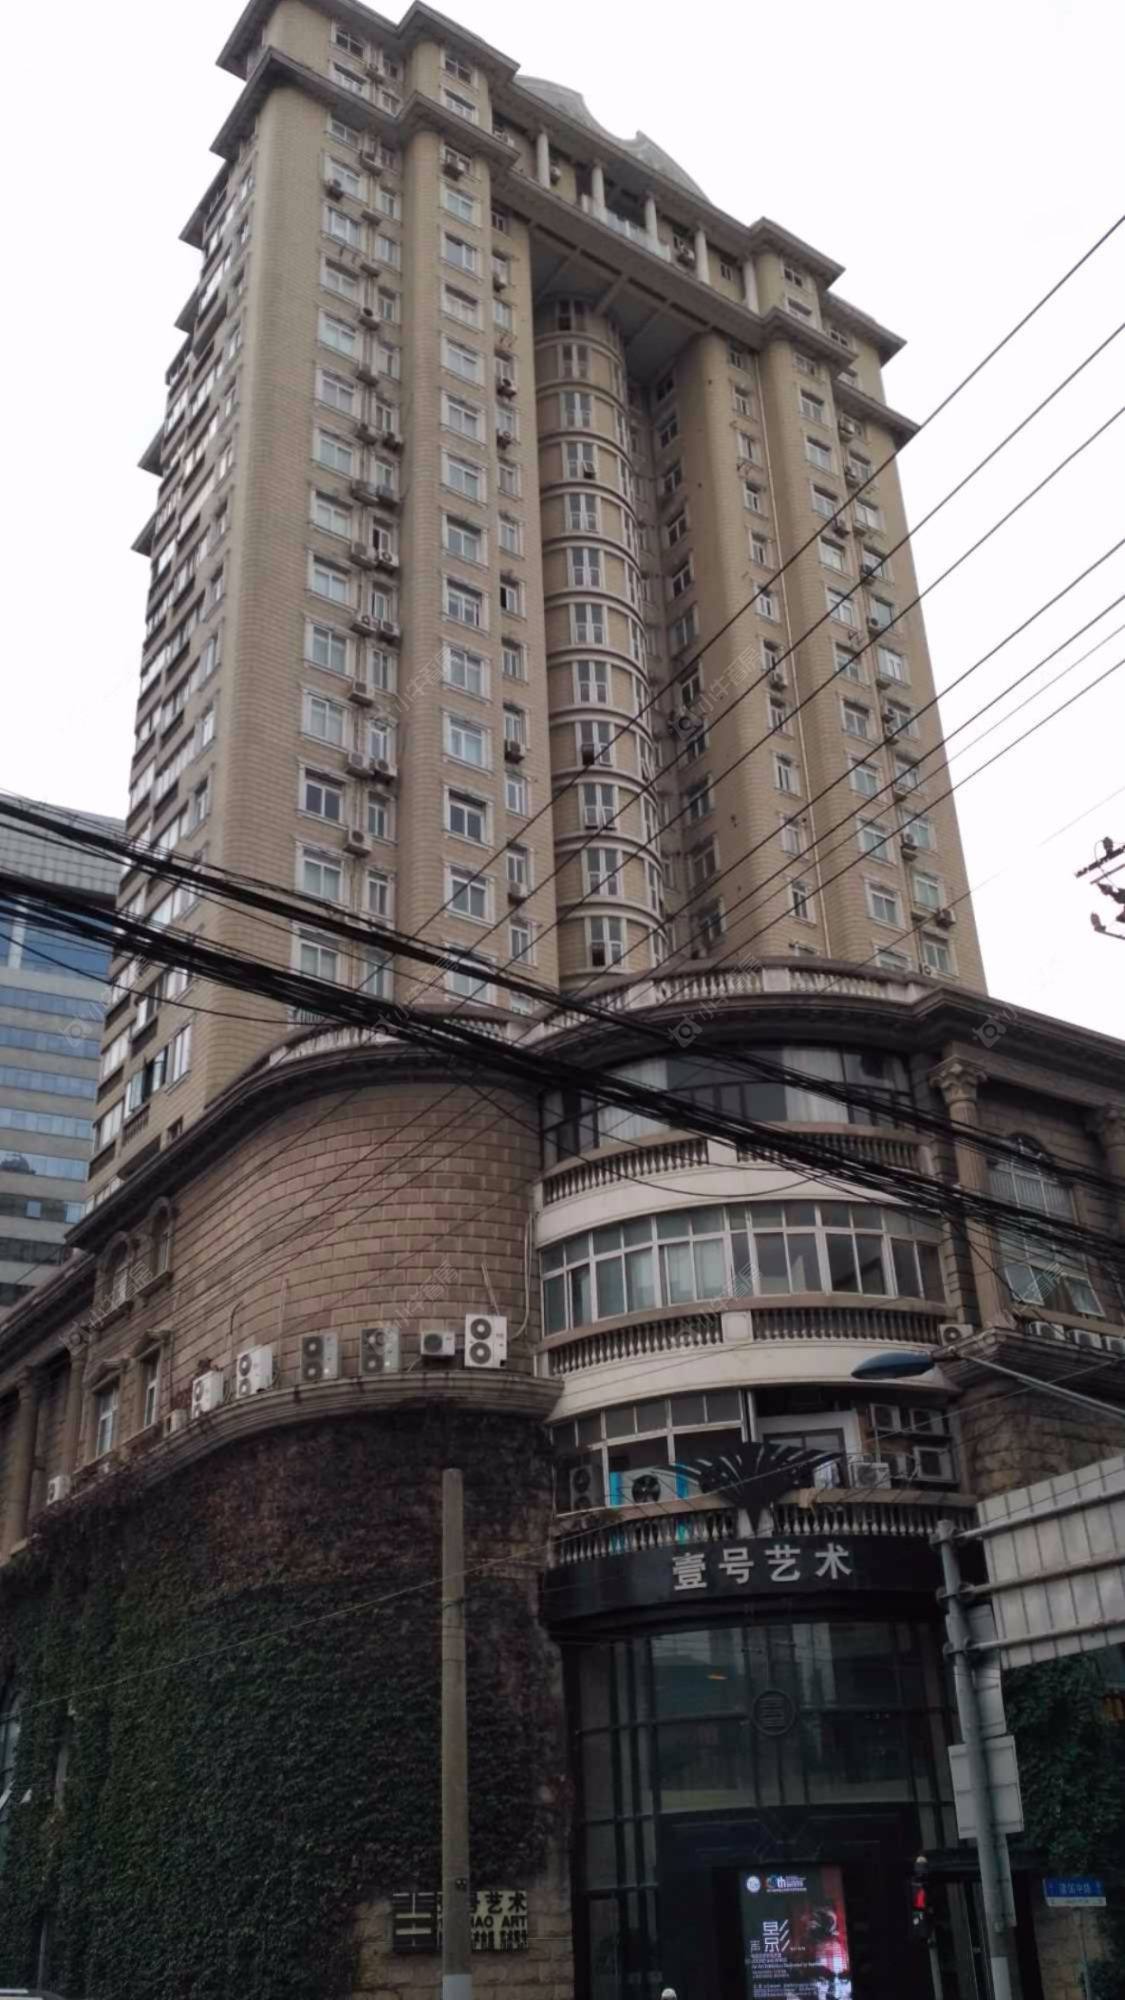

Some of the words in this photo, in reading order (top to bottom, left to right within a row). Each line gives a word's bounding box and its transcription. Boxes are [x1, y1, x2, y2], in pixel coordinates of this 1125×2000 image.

[672, 1542, 853, 1591] 壹号艺术
[502, 1915, 527, 1928] ART
